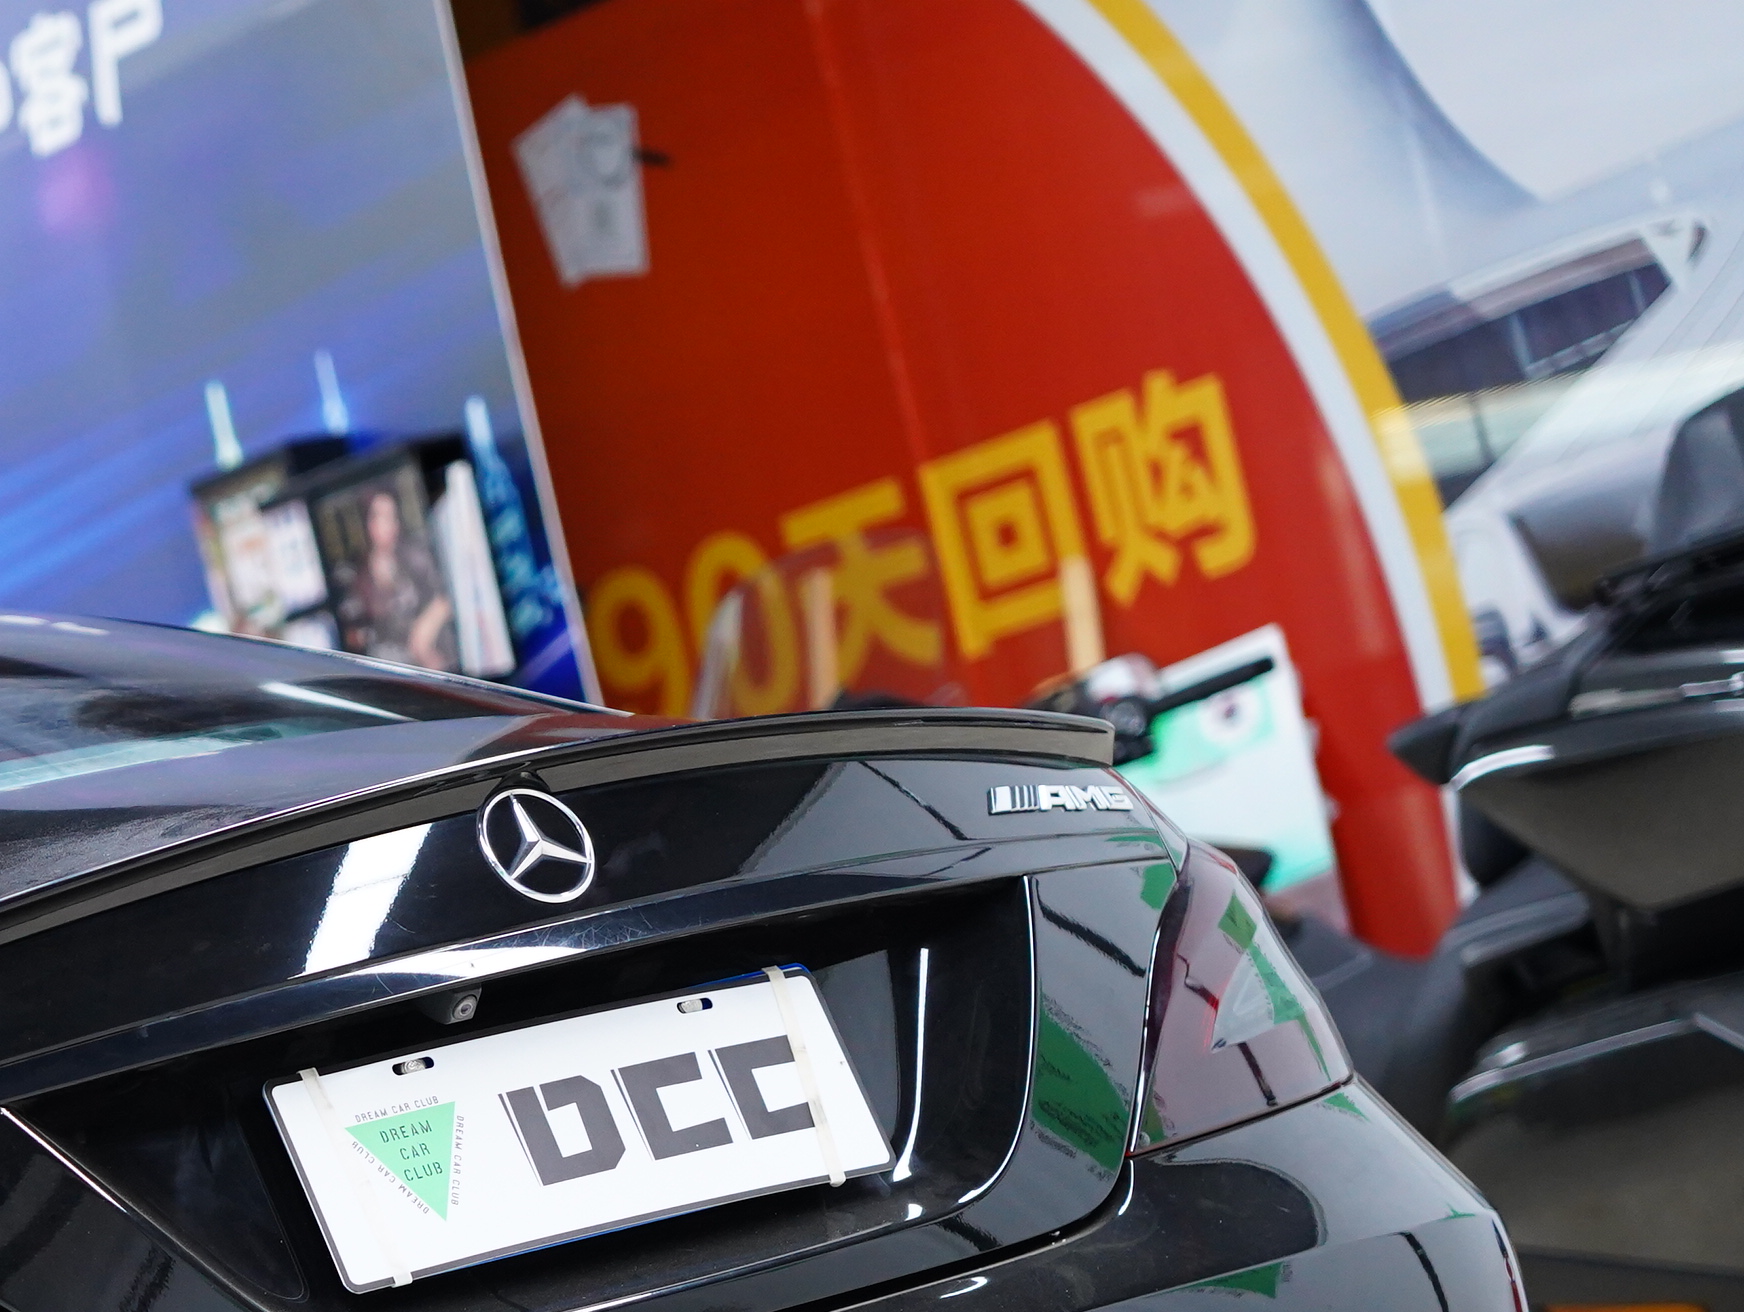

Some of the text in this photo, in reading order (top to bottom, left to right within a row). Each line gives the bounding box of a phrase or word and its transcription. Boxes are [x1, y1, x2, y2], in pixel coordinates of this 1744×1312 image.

[1037, 785, 1134, 812] AMG
[355, 1095, 439, 1123] DREAM CAR CLUB
[498, 1034, 816, 1187] DCC
[379, 1119, 433, 1143] DREAM
[399, 1142, 431, 1160] CAR
[450, 1115, 465, 1206] DREAM CAR CLUB
[351, 1140, 430, 1214] DREAM CAR CLUB
[403, 1161, 443, 1182] CLUB
